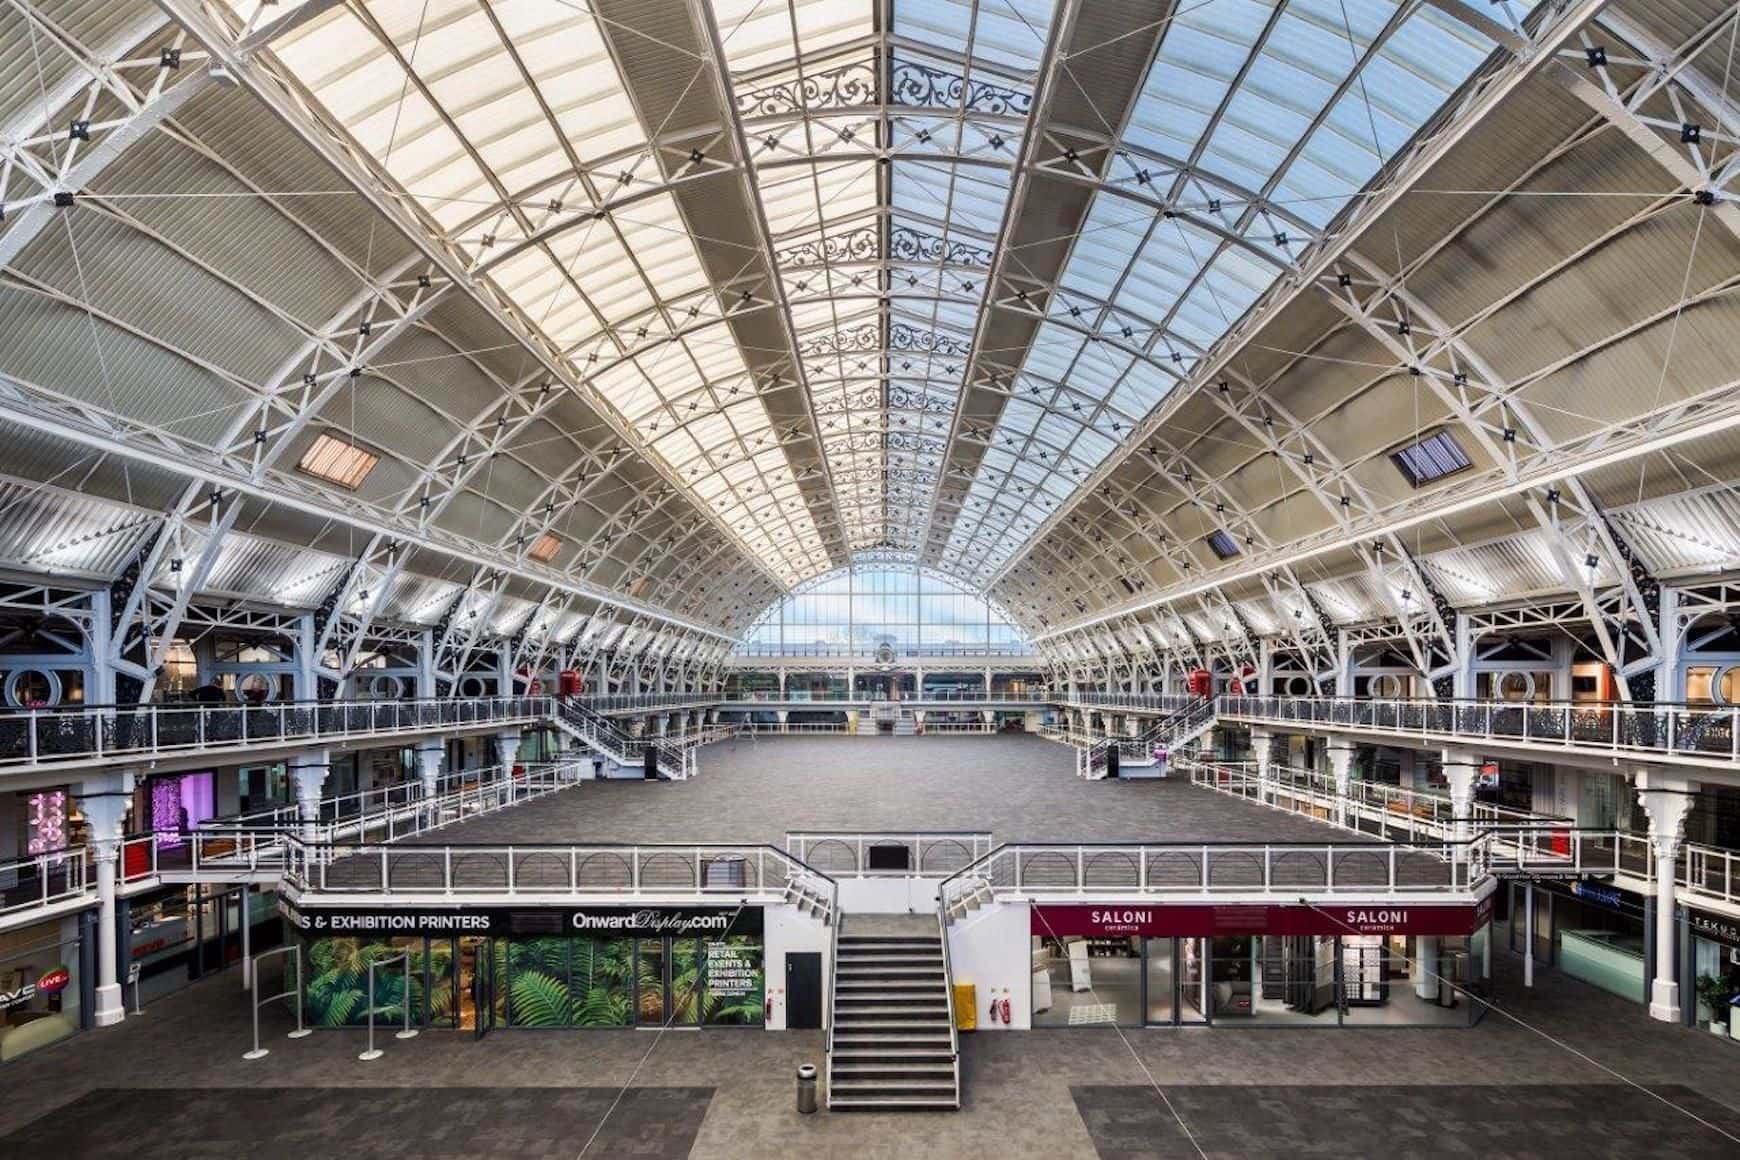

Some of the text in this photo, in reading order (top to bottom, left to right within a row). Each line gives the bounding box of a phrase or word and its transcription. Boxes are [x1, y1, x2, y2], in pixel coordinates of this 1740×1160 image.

[315, 916, 327, 928] &
[331, 916, 415, 928] EXHIBITION
[419, 916, 490, 928] PRINTERS
[573, 910, 727, 934] OnwardDisplay.com
[1091, 911, 1152, 923] SALONI
[1347, 911, 1407, 923] SALONI
